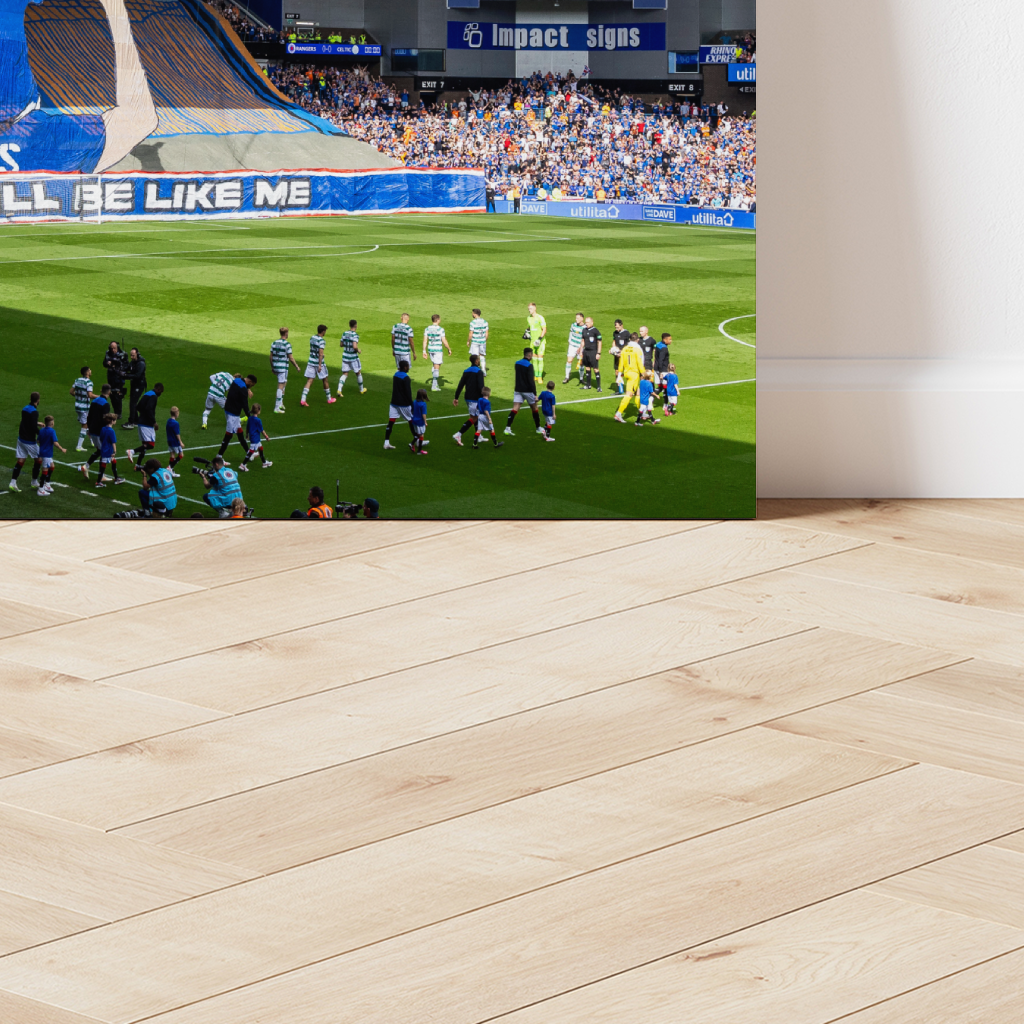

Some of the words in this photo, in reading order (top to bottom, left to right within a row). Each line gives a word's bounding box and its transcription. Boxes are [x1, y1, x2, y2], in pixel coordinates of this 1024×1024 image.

[492, 23, 569, 50] Impact
[586, 25, 640, 50] signs
[710, 46, 736, 55] RHINO
[736, 67, 756, 80] util
[421, 80, 437, 88] EXIT
[74, 182, 134, 211] BE
[144, 180, 242, 211] LIKE
[254, 179, 311, 207] ME
[522, 204, 545, 213] DAVE
[571, 206, 607, 217] utilita
[653, 209, 674, 219] DAVE
[692, 212, 724, 226] utilita
